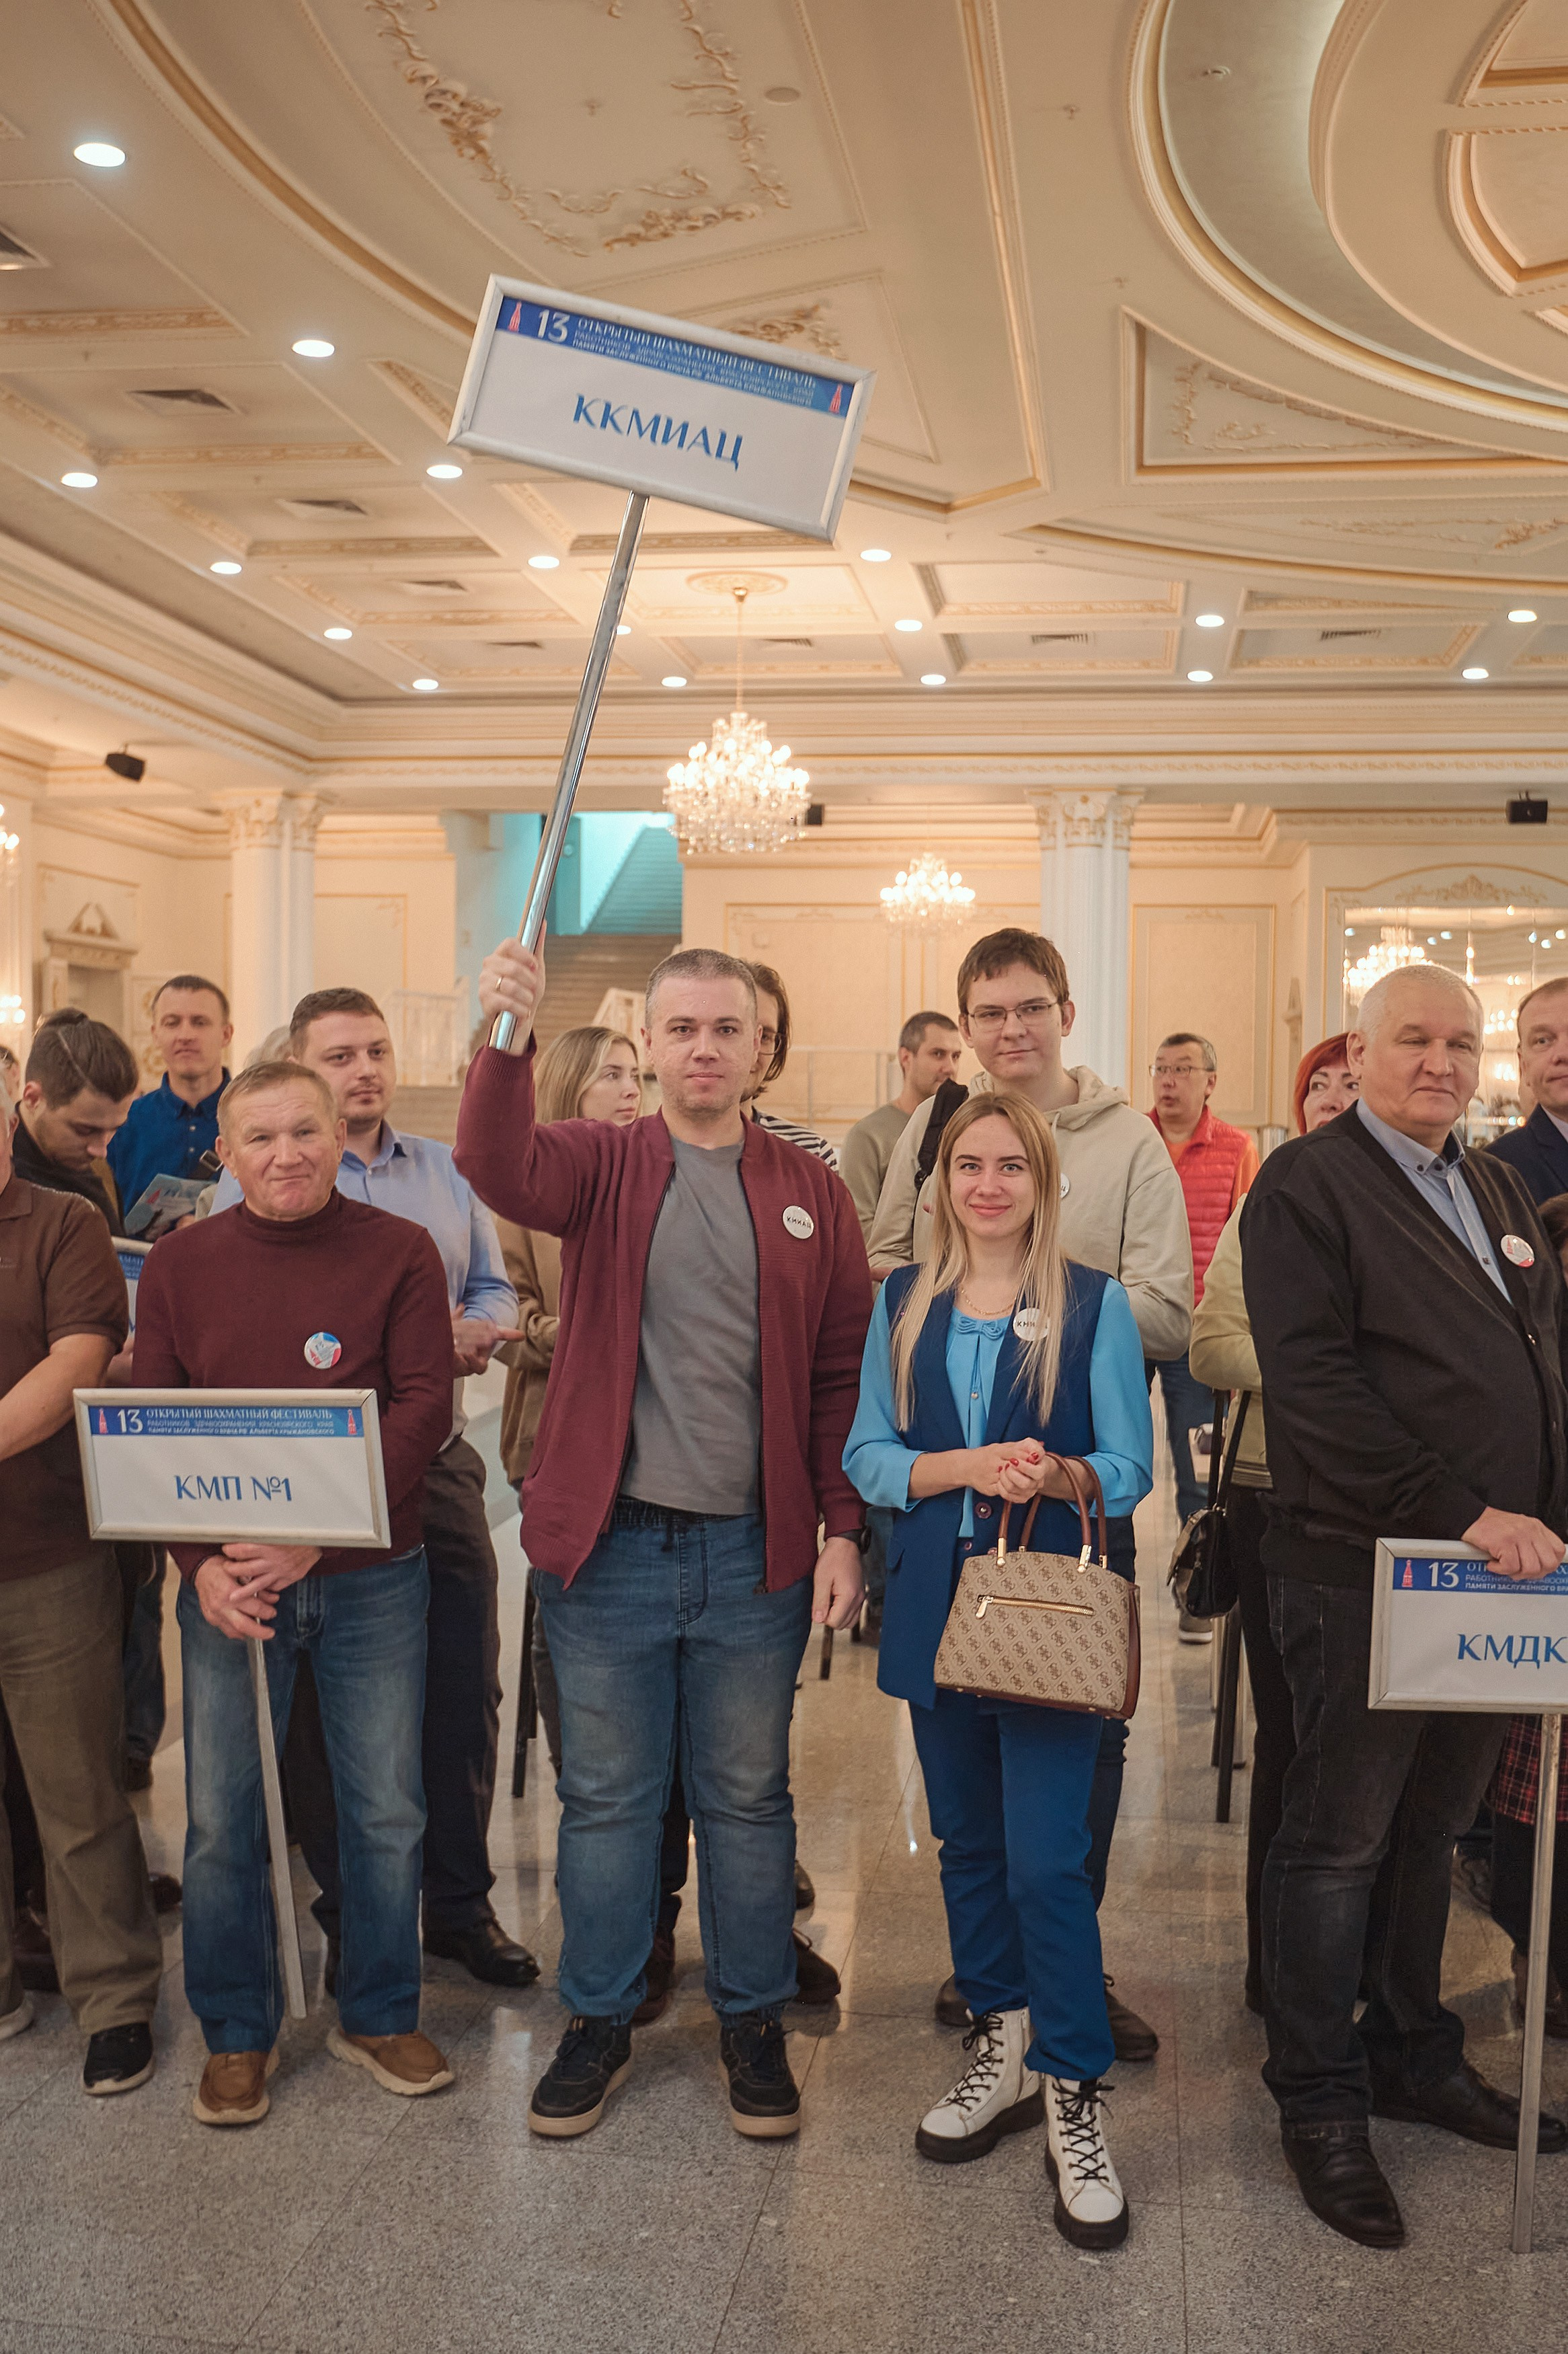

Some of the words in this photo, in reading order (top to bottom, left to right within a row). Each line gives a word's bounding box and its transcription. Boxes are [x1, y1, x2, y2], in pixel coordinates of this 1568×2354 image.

[539, 309, 570, 342] 13
[574, 393, 742, 471] ККМИАЦ
[118, 1408, 143, 1433] 13
[146, 1407, 202, 1418] ОТКРЫТЫЙ
[204, 1407, 269, 1420] ШАХМАТНЫЙ
[270, 1408, 333, 1420] ФЕСТИВАЛЬ
[174, 1475, 242, 1501] КМП
[251, 1476, 292, 1501] №1
[1428, 1562, 1459, 1588] 13
